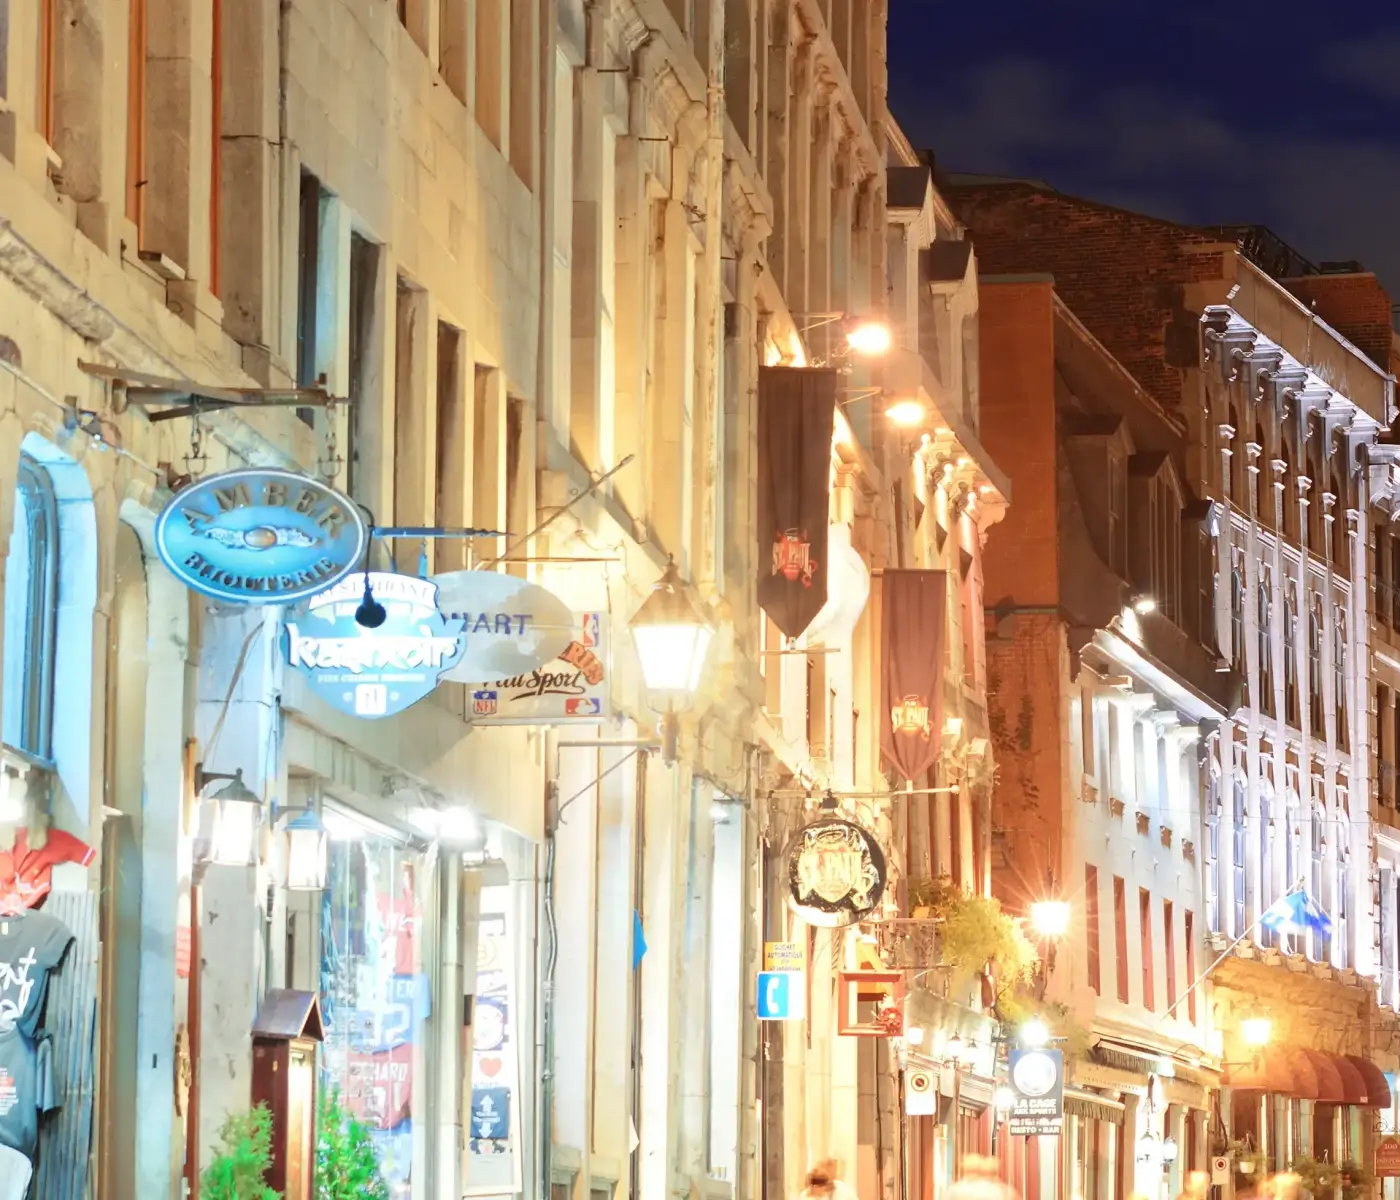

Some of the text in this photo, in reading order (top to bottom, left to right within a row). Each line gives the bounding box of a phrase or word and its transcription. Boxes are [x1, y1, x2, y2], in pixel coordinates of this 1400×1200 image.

[181, 481, 349, 539] AMBER
[184, 551, 337, 591] BIJOUTERIE
[475, 704, 496, 714] NFL
[1014, 1098, 1028, 1108] LA
